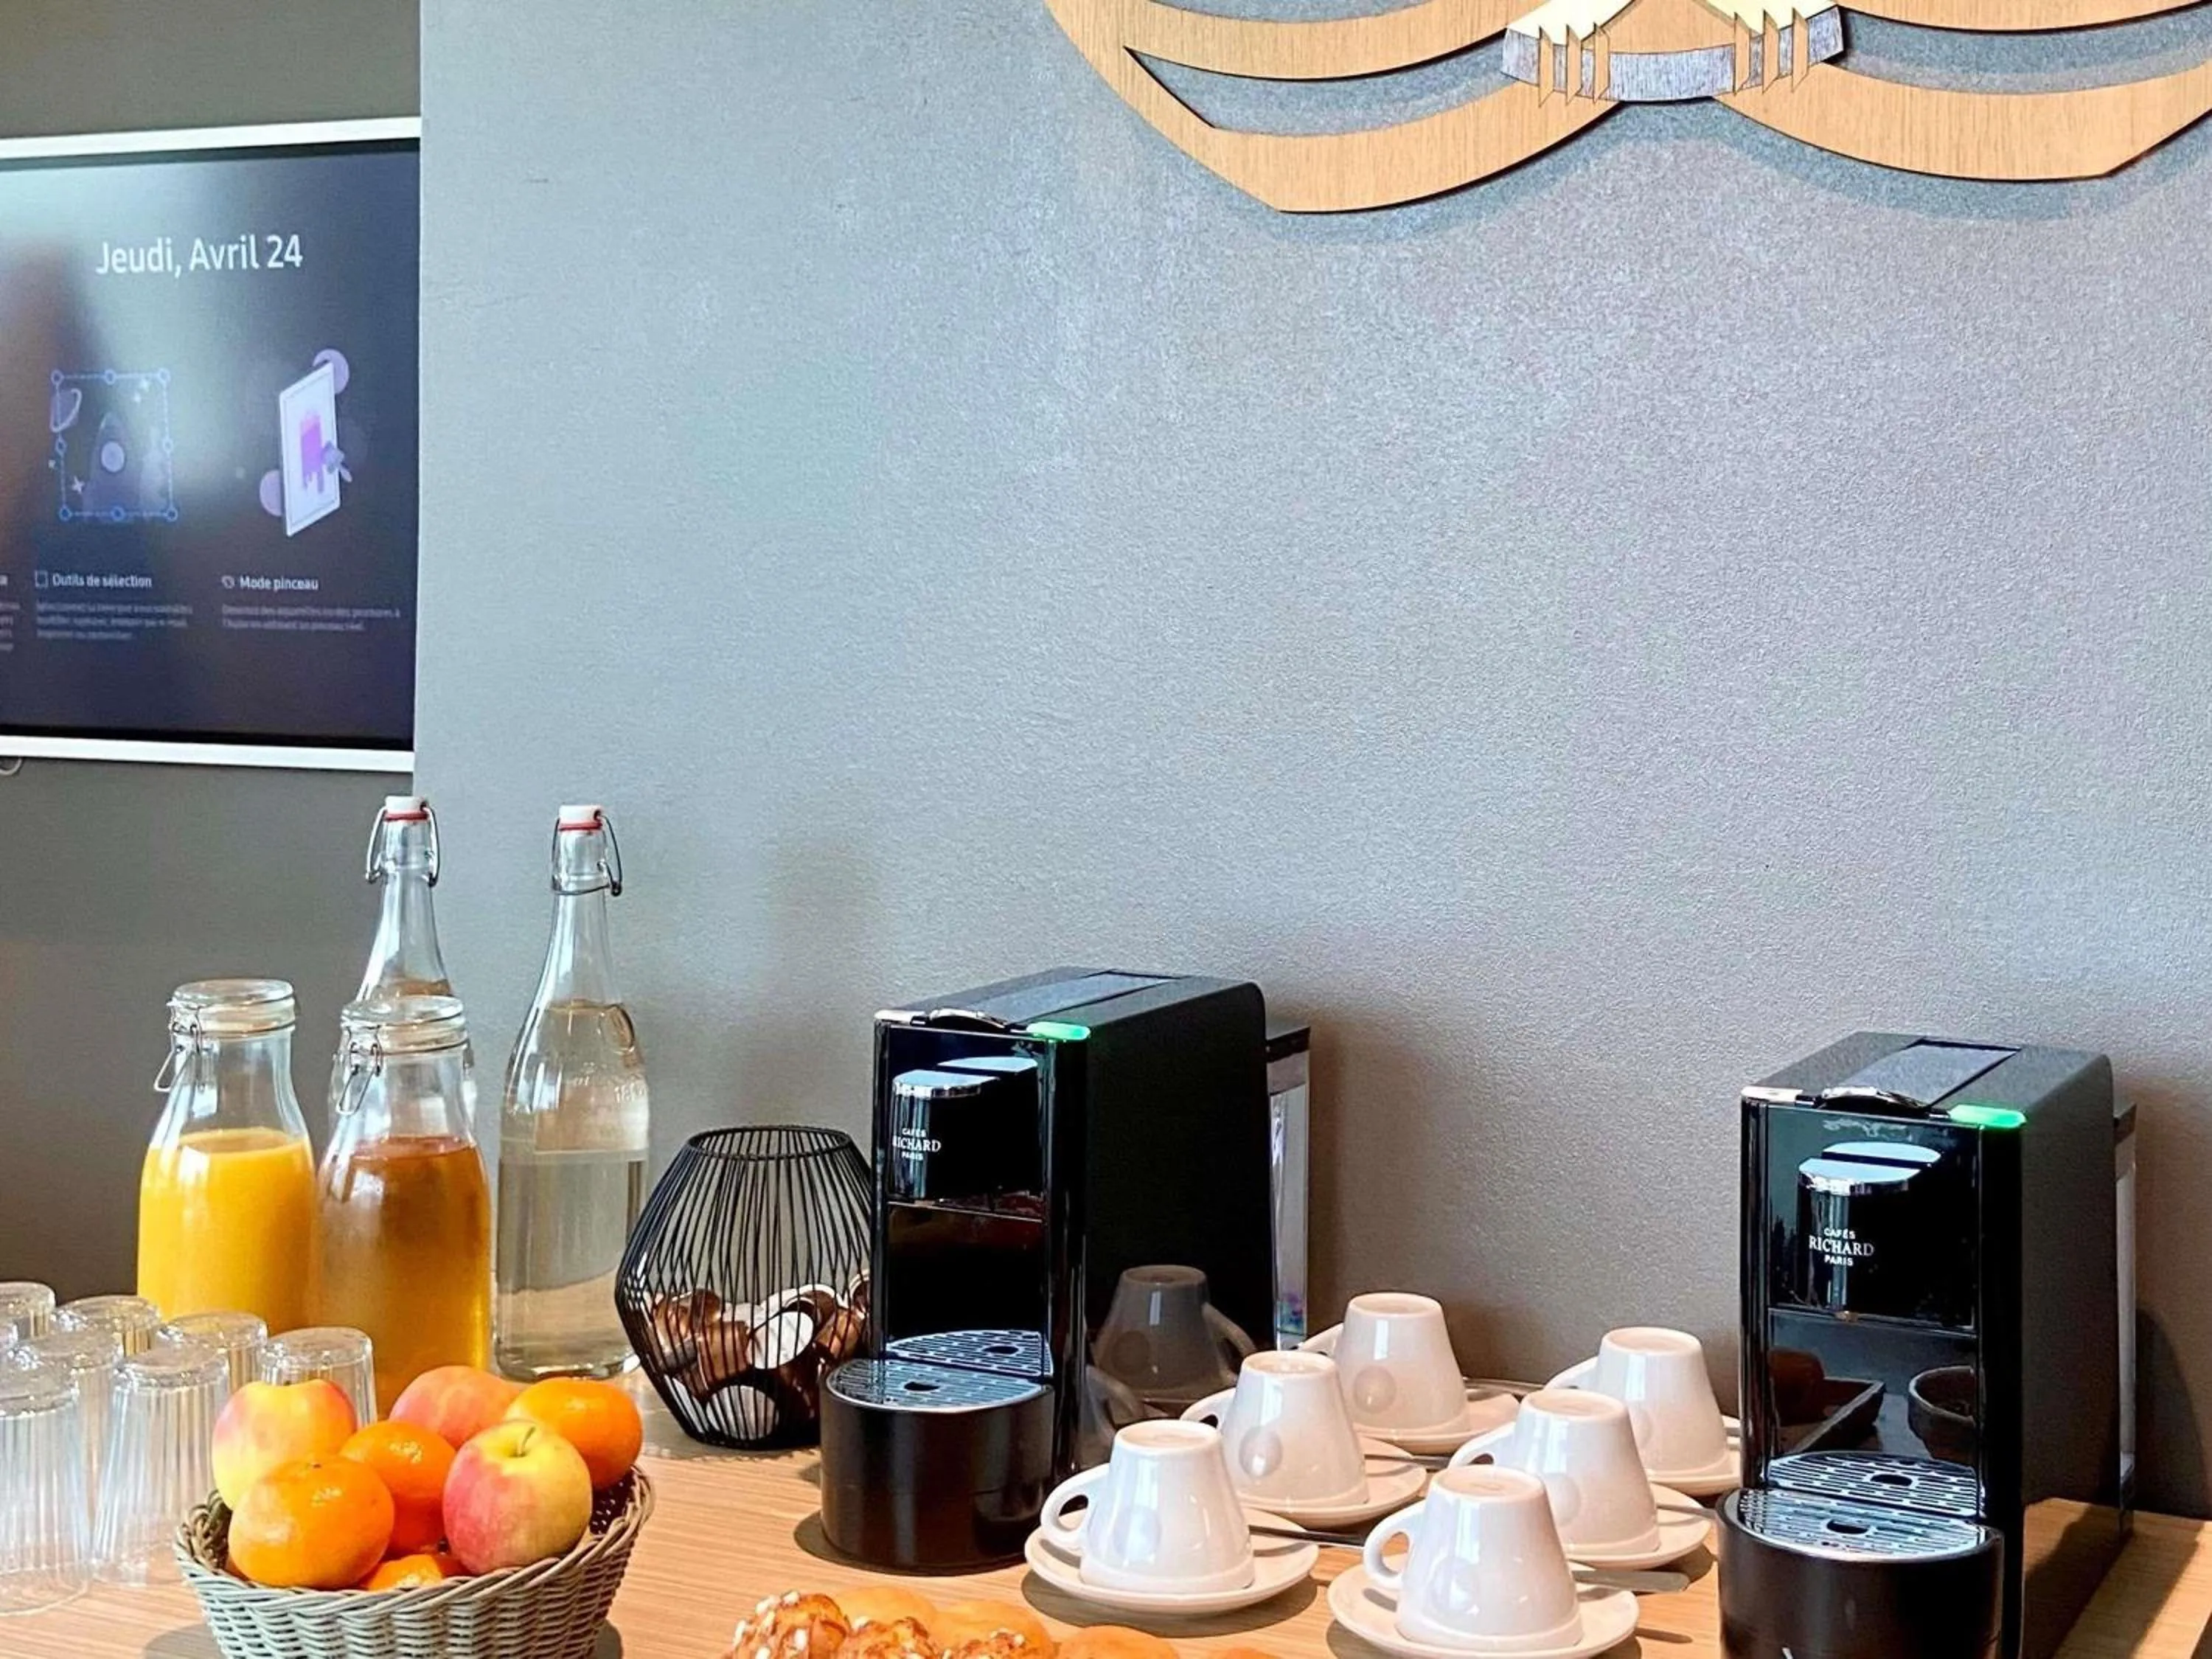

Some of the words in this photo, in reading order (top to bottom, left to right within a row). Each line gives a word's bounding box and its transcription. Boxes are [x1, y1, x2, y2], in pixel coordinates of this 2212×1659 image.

[96, 237, 181, 279] Jeudi,
[189, 234, 260, 271] Avril
[266, 234, 304, 268] 24
[52, 573, 85, 587] Outils
[86, 574, 100, 588] de
[240, 575, 272, 589] Mode
[274, 577, 319, 592] pinceau
[1809, 1235, 1874, 1256] RICHARD
[1824, 1254, 1854, 1267] PARIS
